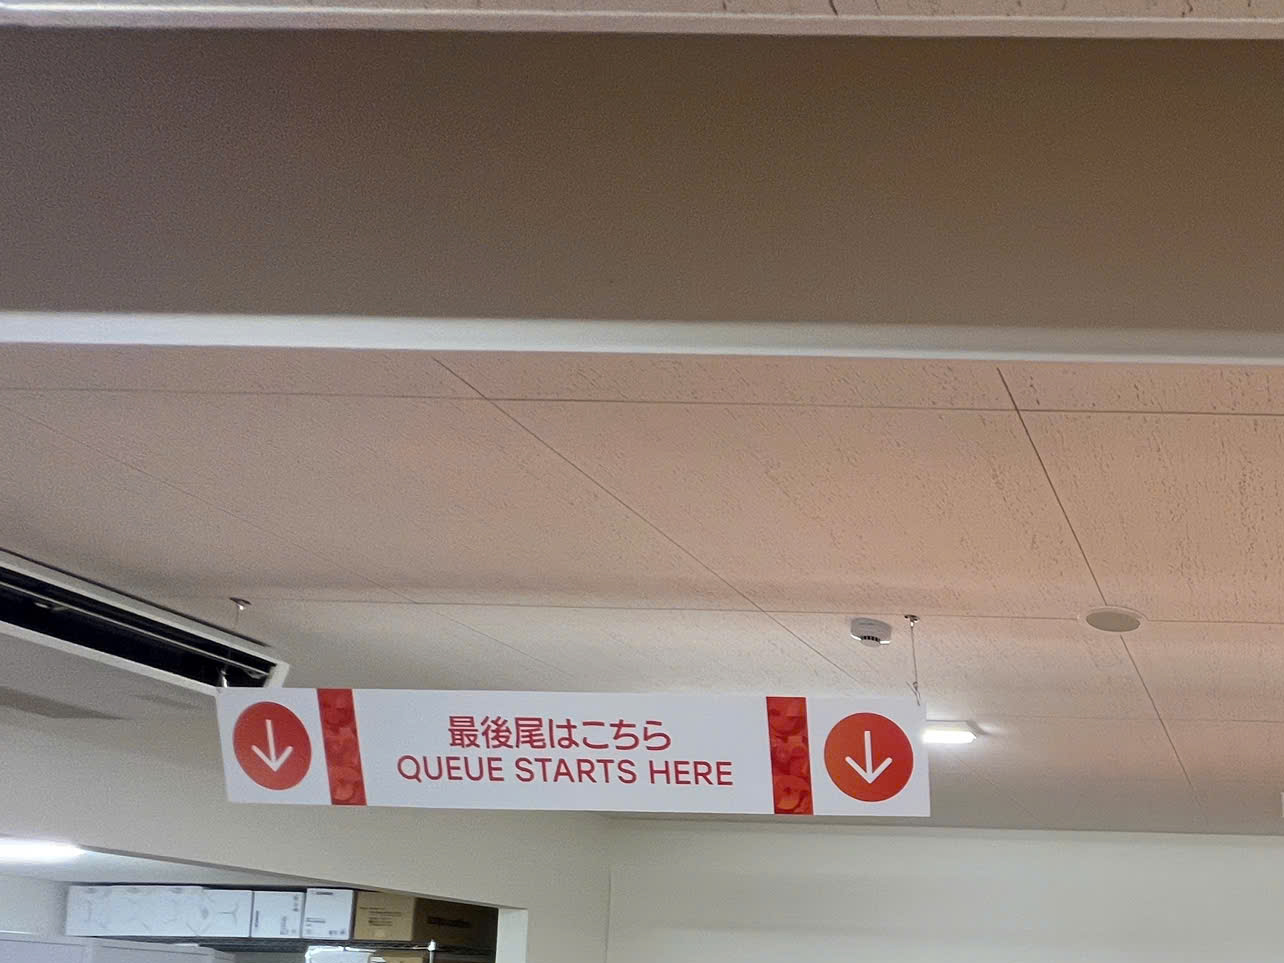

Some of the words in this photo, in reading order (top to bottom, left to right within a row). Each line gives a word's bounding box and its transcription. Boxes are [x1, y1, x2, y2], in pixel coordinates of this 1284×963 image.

[447, 714, 673, 752] 最後尾はこちら
[397, 754, 505, 784] QUEUE
[514, 757, 638, 785] STARTS
[648, 759, 734, 787] HERE
